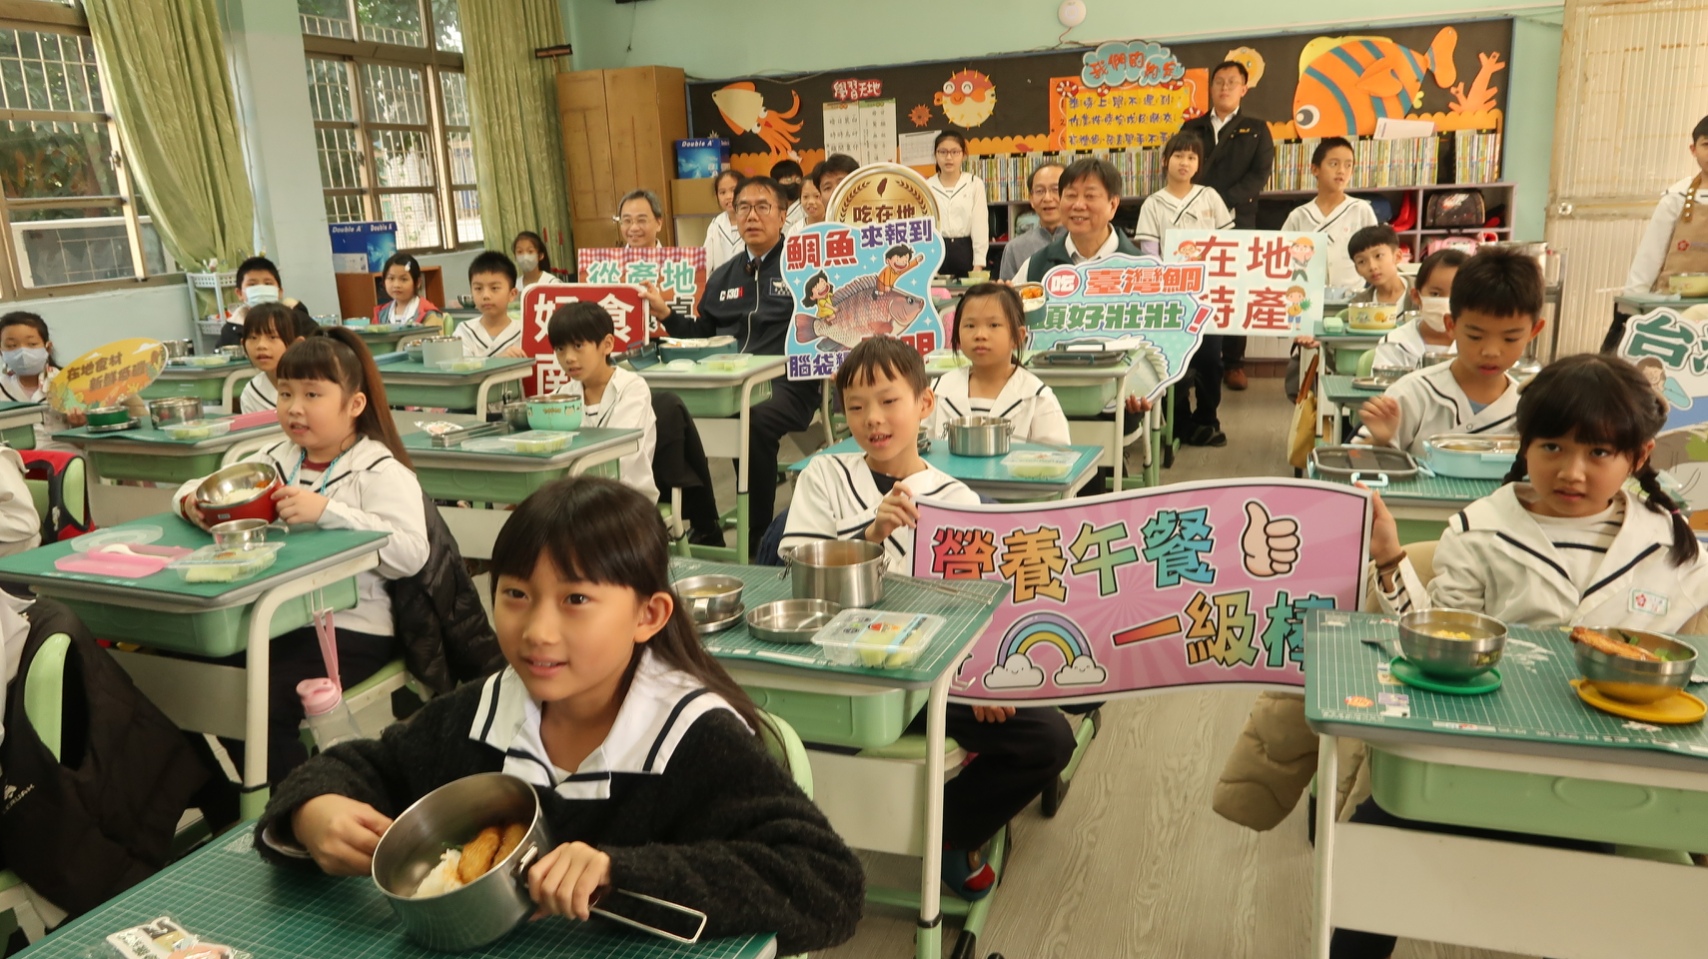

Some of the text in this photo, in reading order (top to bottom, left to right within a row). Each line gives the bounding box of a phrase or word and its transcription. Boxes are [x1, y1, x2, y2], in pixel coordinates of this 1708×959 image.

[833, 80, 881, 99] 學習天地
[370, 224, 387, 232] Double
[852, 204, 916, 223] 吃在地
[588, 261, 696, 294] 從產地
[1195, 235, 1293, 279] 在地
[1199, 284, 1291, 331] 特產
[1627, 315, 1708, 373] 台
[931, 507, 1216, 603] 營養午餐
[1112, 589, 1337, 668] 一級棒
